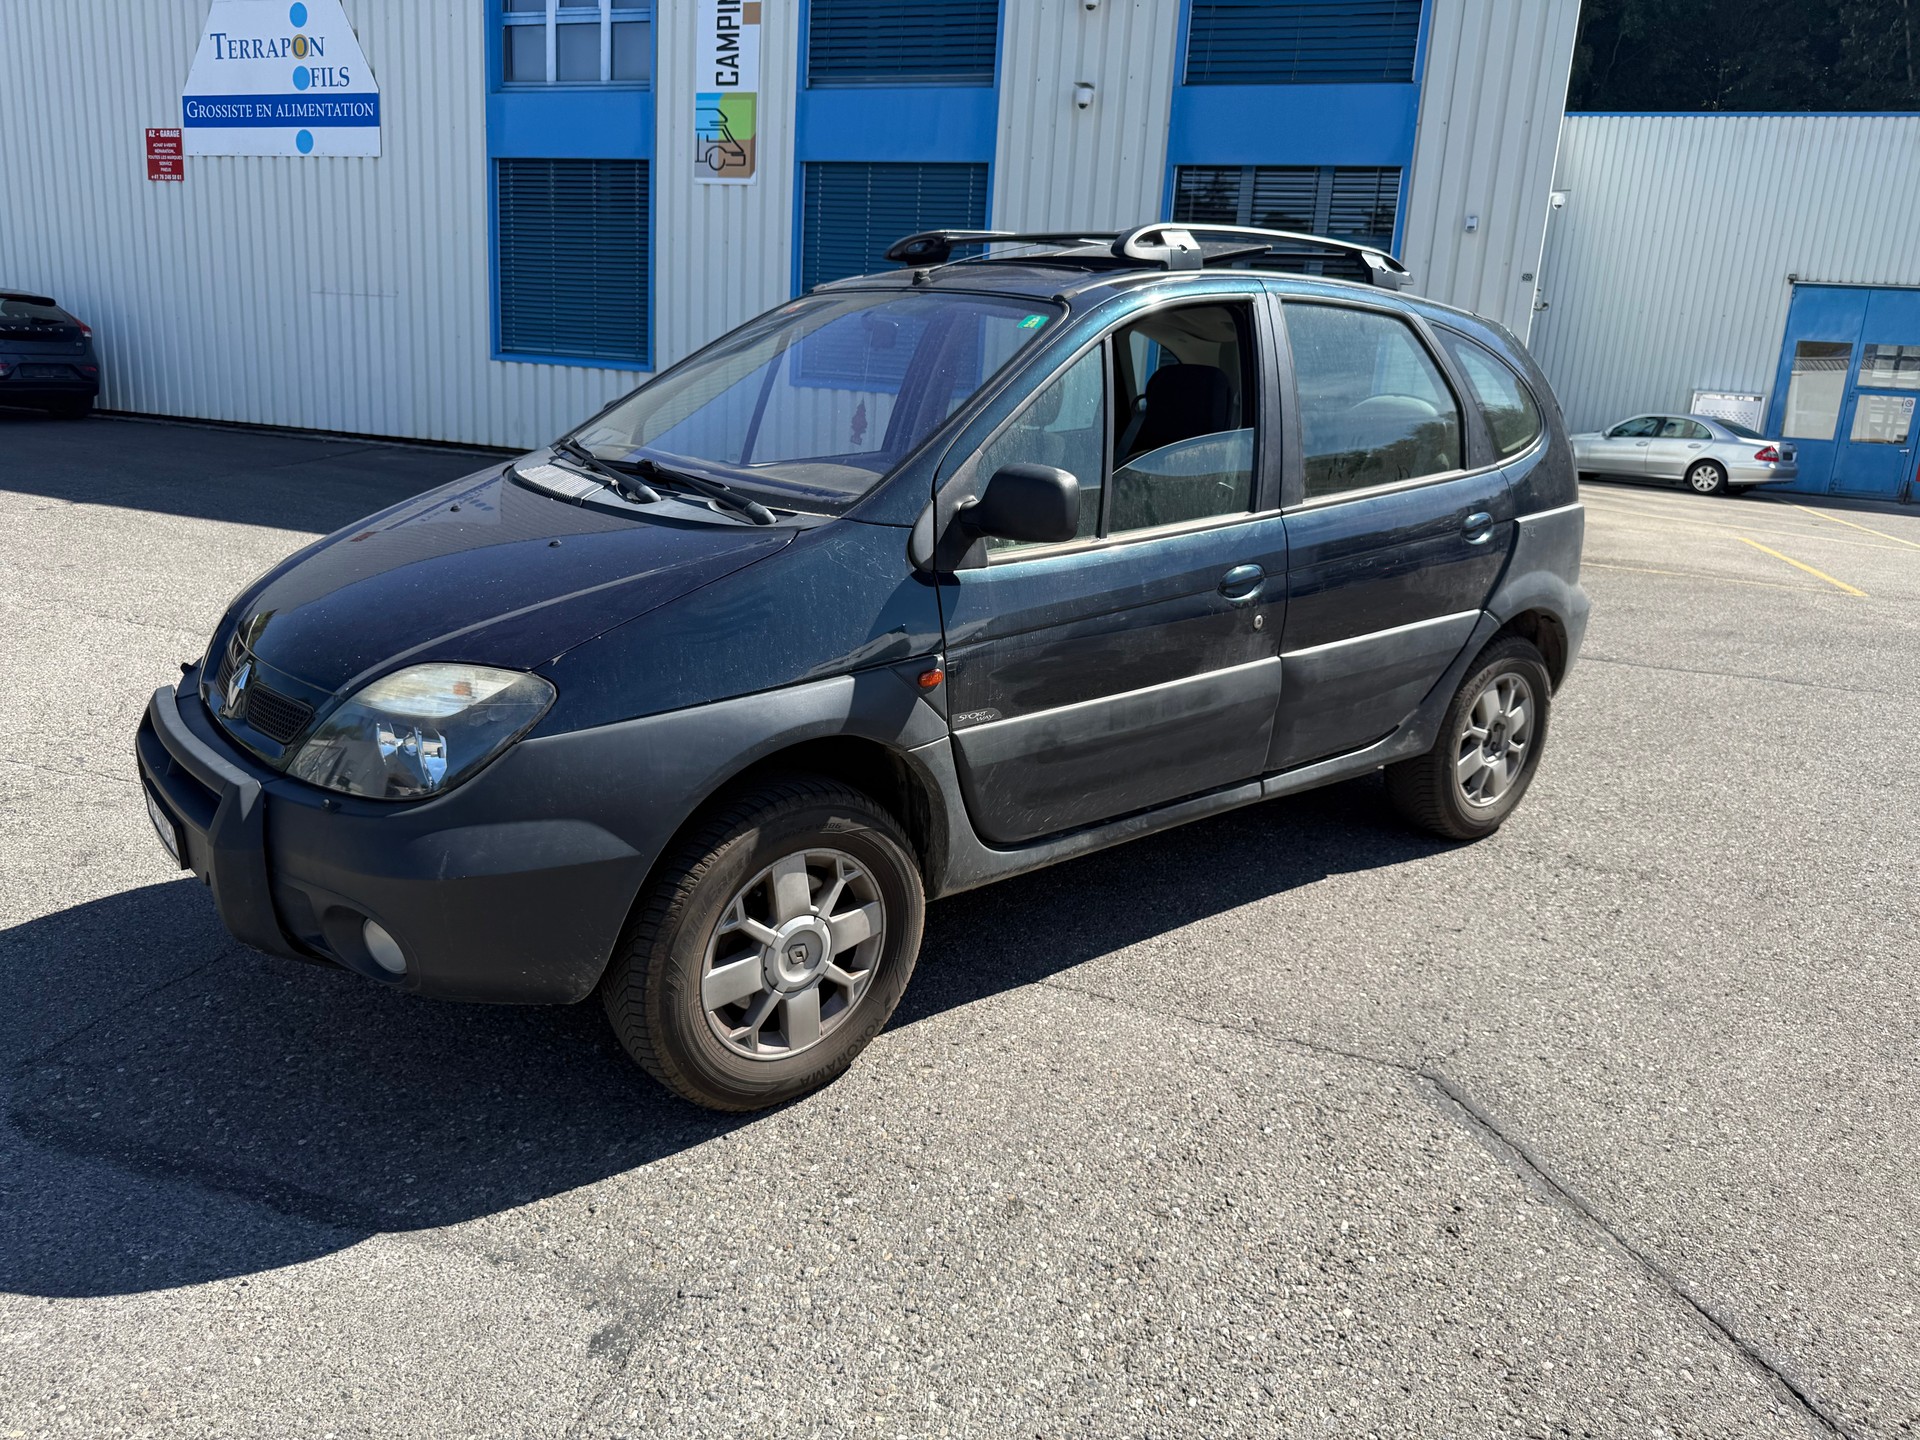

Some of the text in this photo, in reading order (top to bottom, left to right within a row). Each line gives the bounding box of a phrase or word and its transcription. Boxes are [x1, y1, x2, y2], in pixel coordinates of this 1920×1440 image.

[210, 32, 325, 60] TERRAPON
[309, 66, 350, 88] FILS
[186, 100, 375, 118] GROSSISTE EN ALIMENTATION
[800, 1016, 883, 1087] YOKOHAMA
